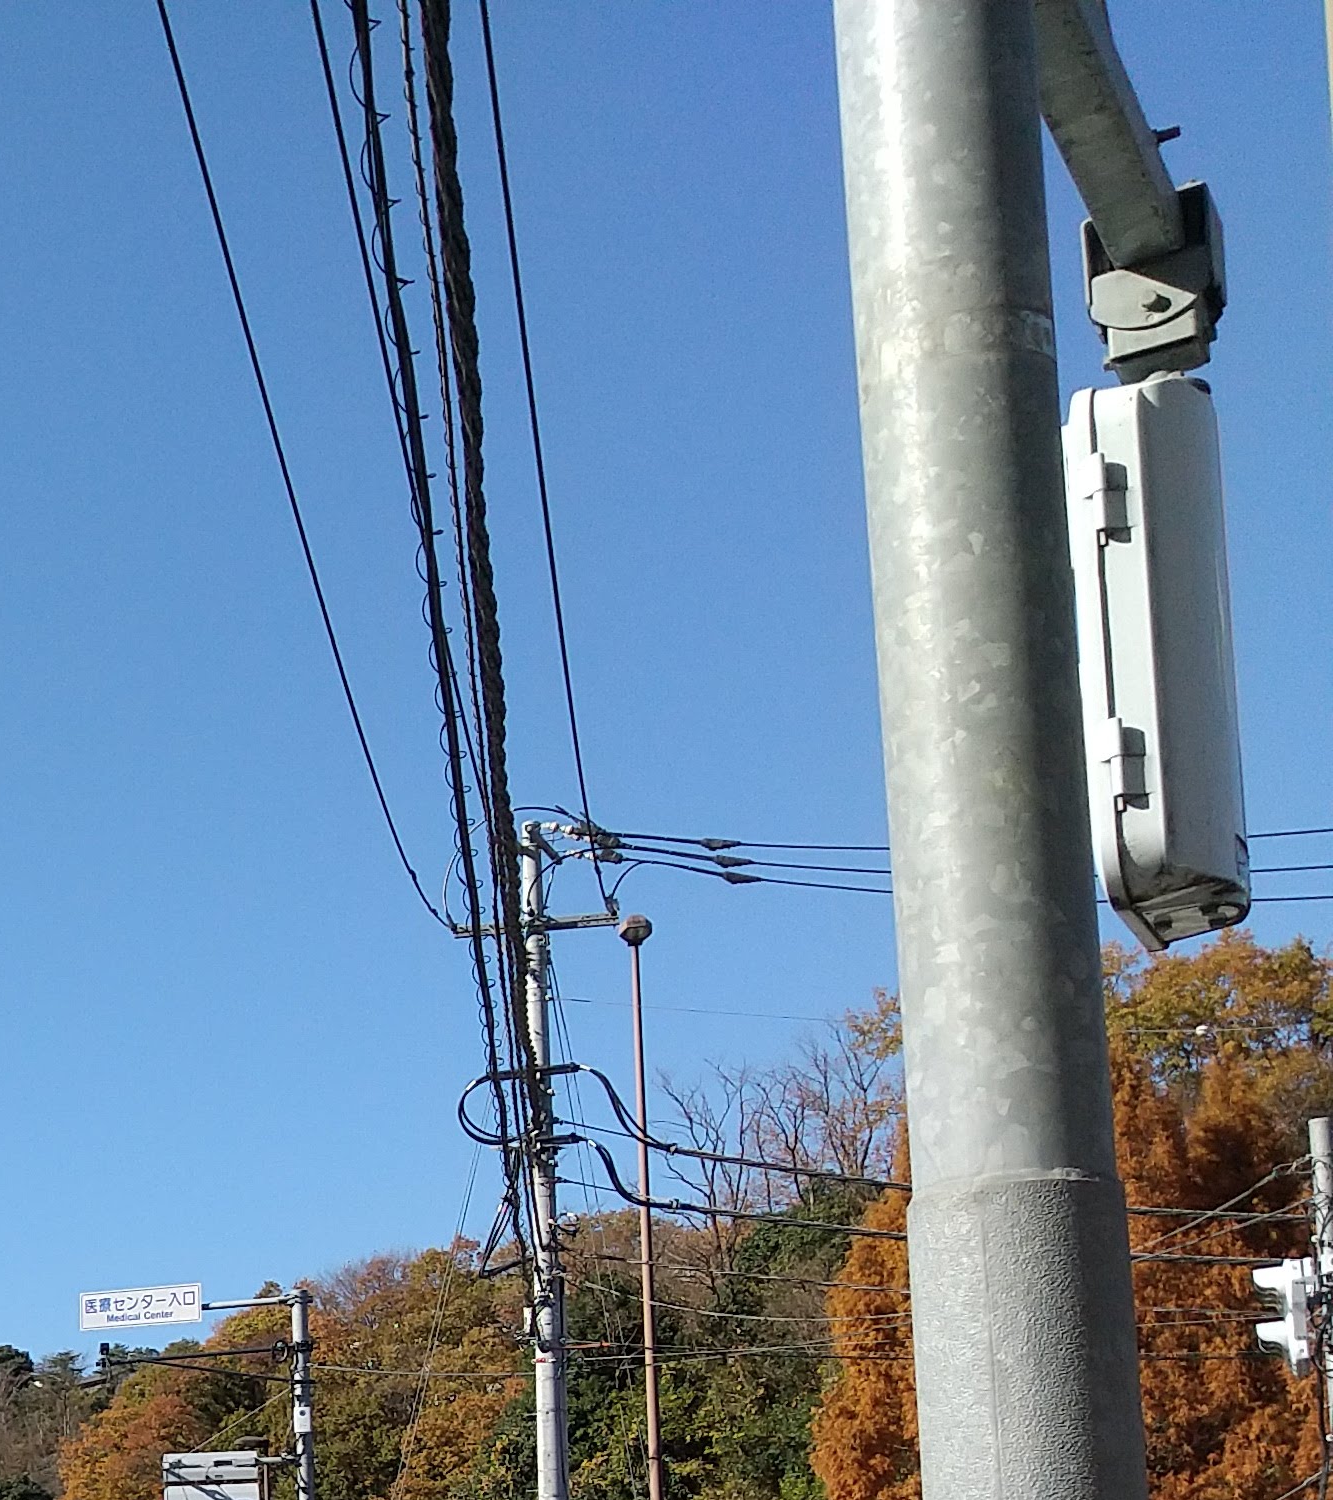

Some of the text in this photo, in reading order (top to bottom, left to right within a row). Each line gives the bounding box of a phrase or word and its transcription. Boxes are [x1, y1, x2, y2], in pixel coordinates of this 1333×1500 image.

[85, 1291, 195, 1313] 医療センター入口
[106, 1311, 174, 1322] Medical Center
